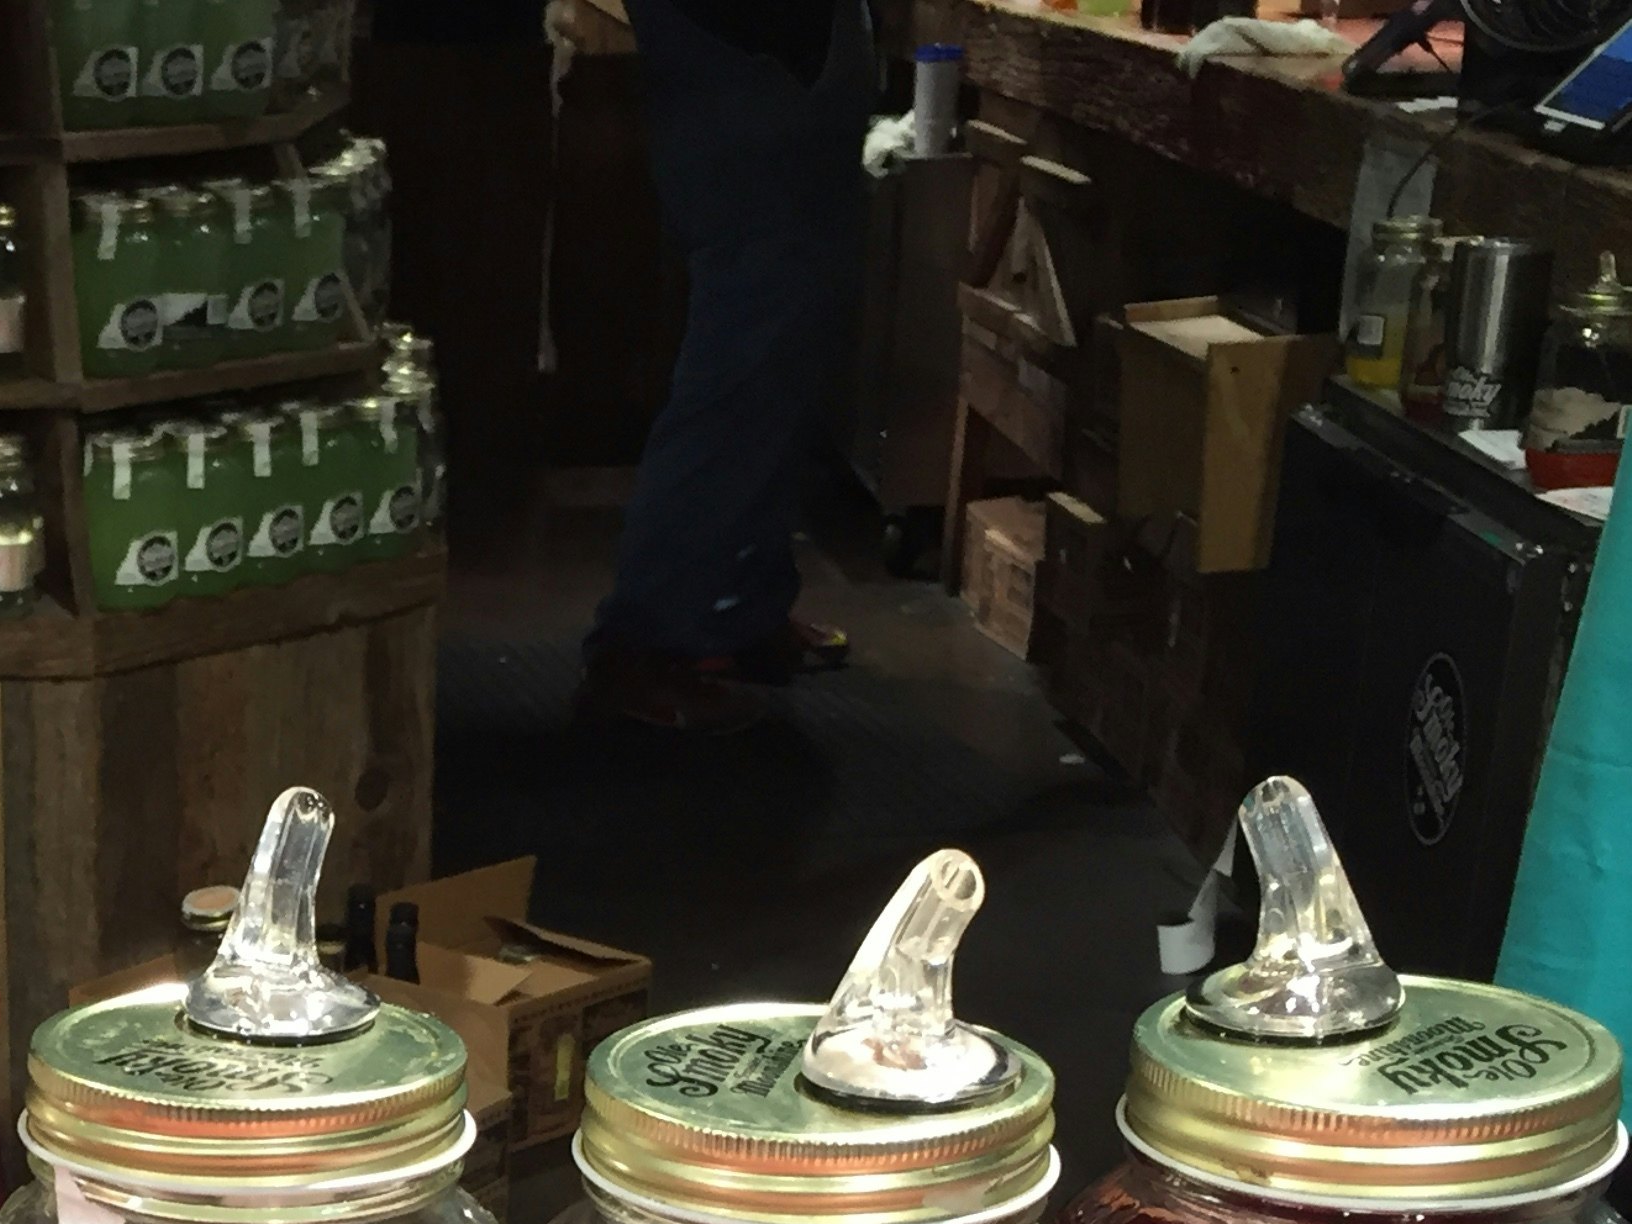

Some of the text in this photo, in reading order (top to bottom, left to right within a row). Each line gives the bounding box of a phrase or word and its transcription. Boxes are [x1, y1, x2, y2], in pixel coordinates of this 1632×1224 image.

[95, 1050, 333, 1094] Smoky
[644, 1033, 696, 1078] Ole
[645, 1023, 772, 1100] Smoky
[1377, 1024, 1568, 1095] Smoky
[1464, 1056, 1537, 1082] Ole
